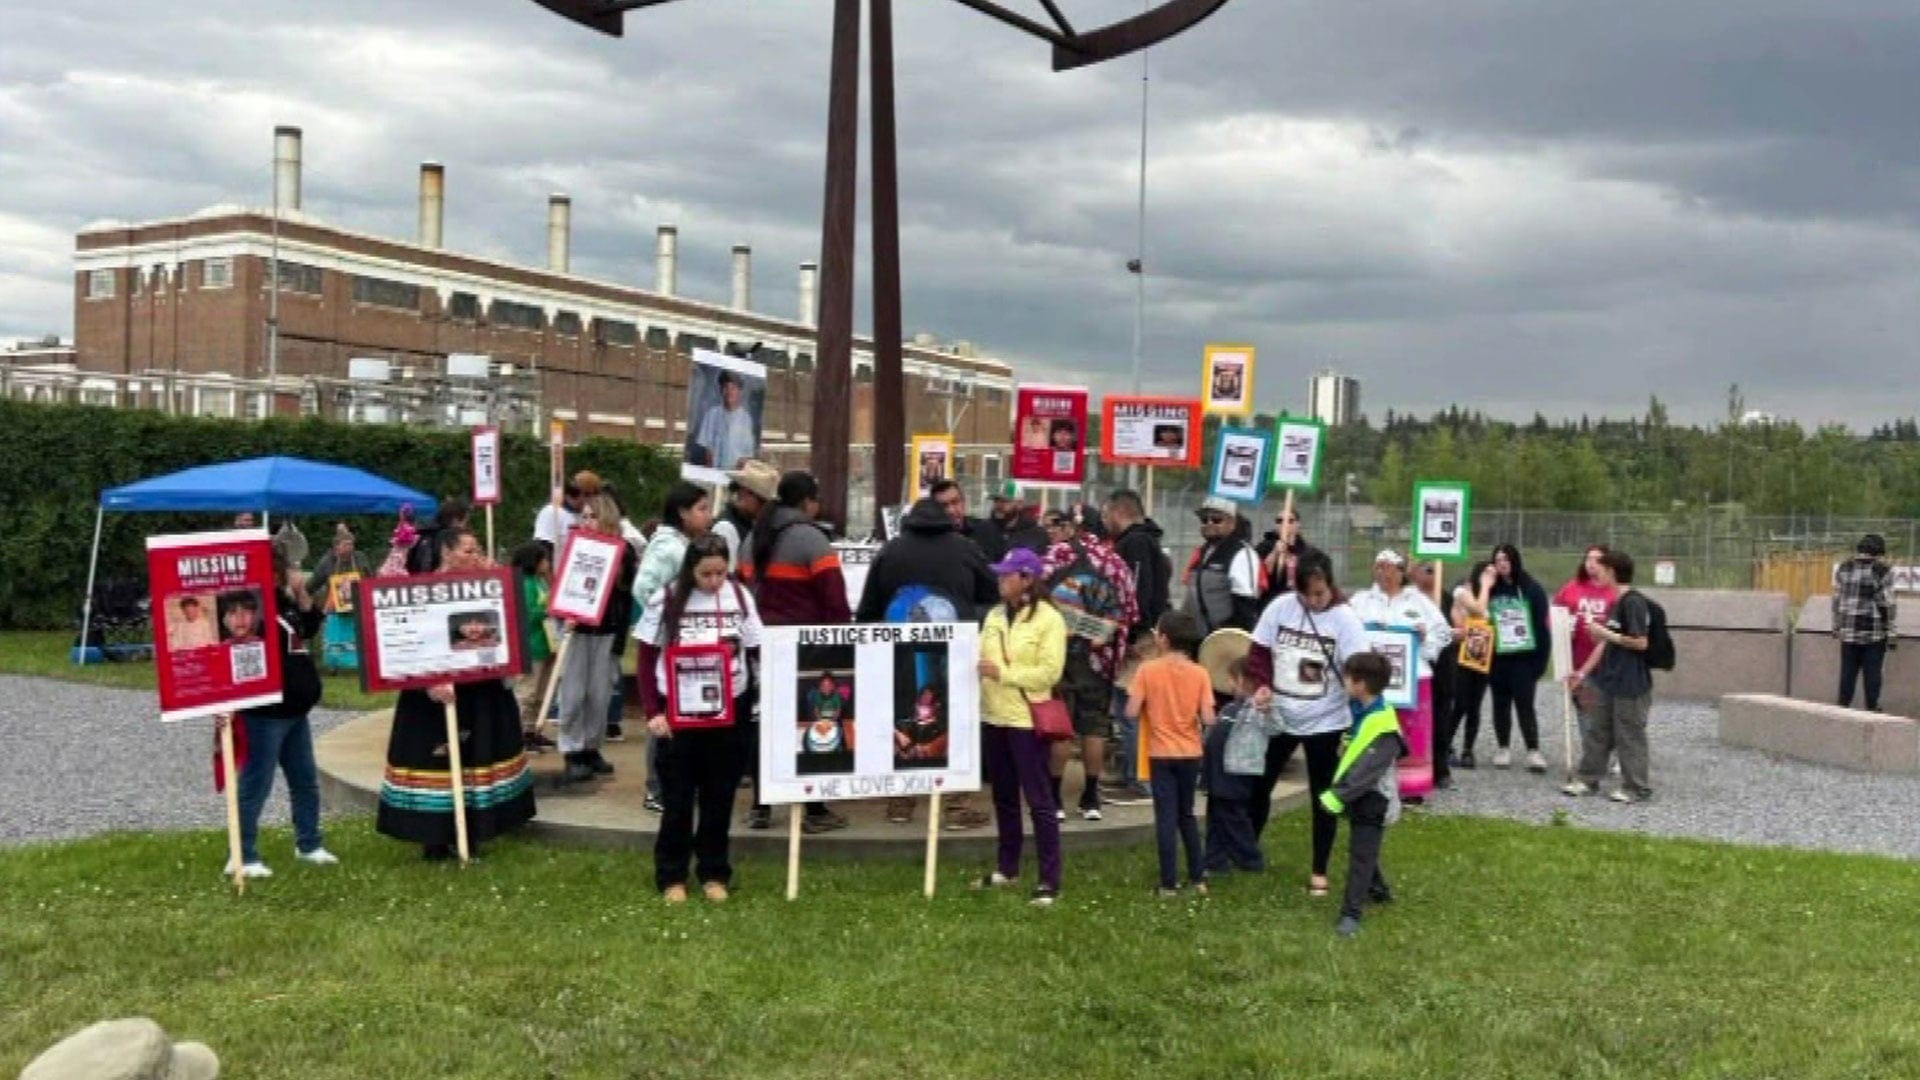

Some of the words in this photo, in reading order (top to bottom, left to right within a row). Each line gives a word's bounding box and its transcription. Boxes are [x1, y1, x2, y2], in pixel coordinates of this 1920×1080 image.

[177, 555, 247, 577] MISSING
[372, 579, 503, 608] MISSING
[800, 627, 868, 645] JUSTICE
[872, 626, 905, 642] FOR
[910, 625, 953, 640] SAM!
[820, 778, 841, 797] WE
[850, 775, 896, 794] LOVE
